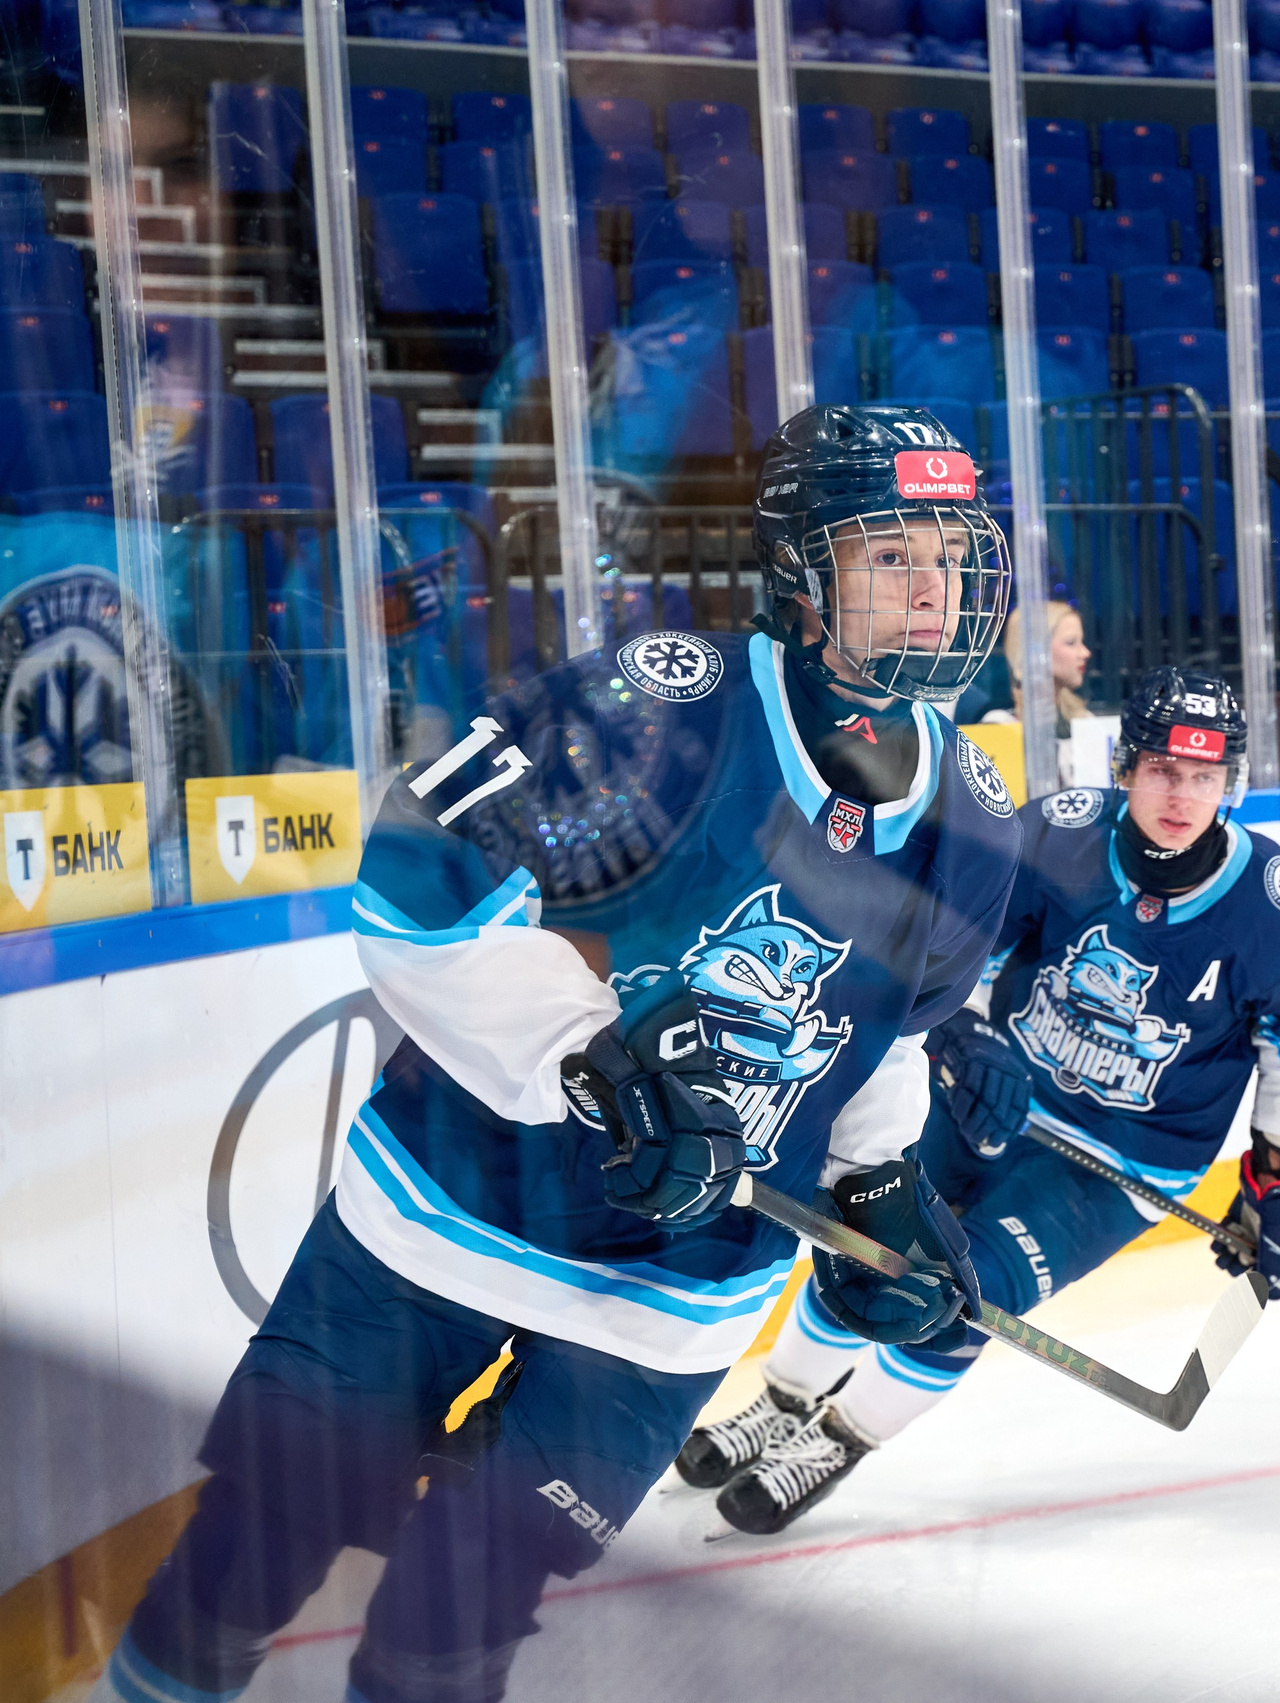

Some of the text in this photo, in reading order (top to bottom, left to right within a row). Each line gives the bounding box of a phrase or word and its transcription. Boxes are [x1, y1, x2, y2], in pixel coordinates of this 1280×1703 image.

[893, 422, 934, 446] 17
[904, 483, 971, 495] OLIMPBET
[706, 654, 720, 675] КЛУБ
[639, 676, 681, 699] ОБЛАСТЬ
[687, 673, 716, 697] СИБИРЬ
[1184, 692, 1217, 719] 53
[408, 715, 533, 828] 17
[835, 808, 861, 826] МХЛ
[262, 812, 336, 855] БАНК
[52, 828, 126, 878] БАНК
[1187, 960, 1221, 1002] A
[716, 1056, 769, 1078] СКИЕ
[632, 1085, 654, 1137] JETSPEED
[850, 1176, 902, 1204] CCM
[981, 1302, 1094, 1378] SOYUZ
